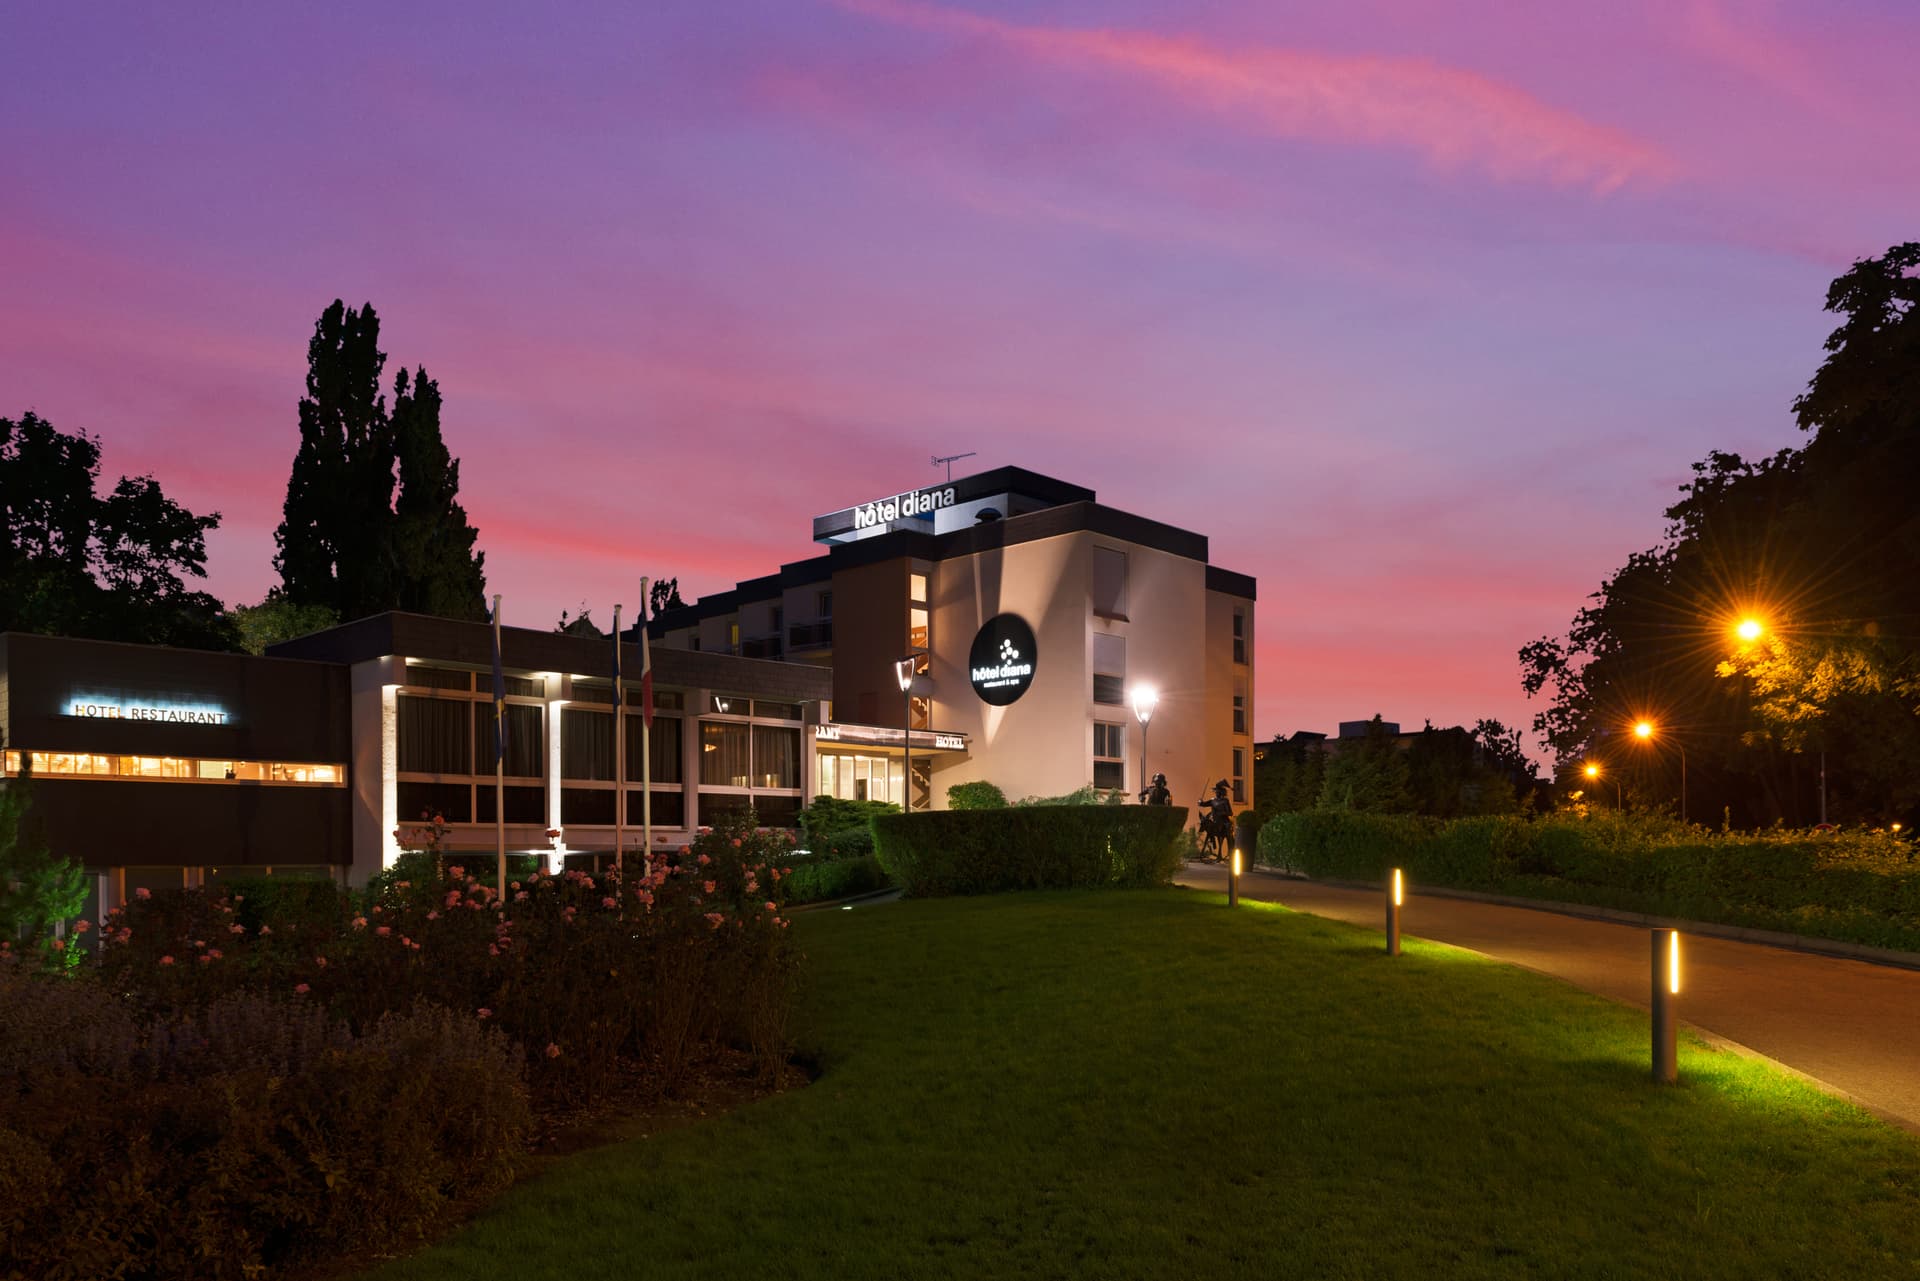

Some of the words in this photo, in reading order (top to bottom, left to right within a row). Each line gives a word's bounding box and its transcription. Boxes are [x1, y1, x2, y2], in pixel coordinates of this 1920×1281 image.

[854, 496, 900, 529] hôtel
[902, 487, 955, 517] diana
[972, 665, 1000, 682] hôtel
[1000, 664, 1031, 678] diana
[75, 704, 125, 719] HOTEL
[131, 708, 225, 725] RESTAURANT
[935, 735, 965, 749] HOTEL
